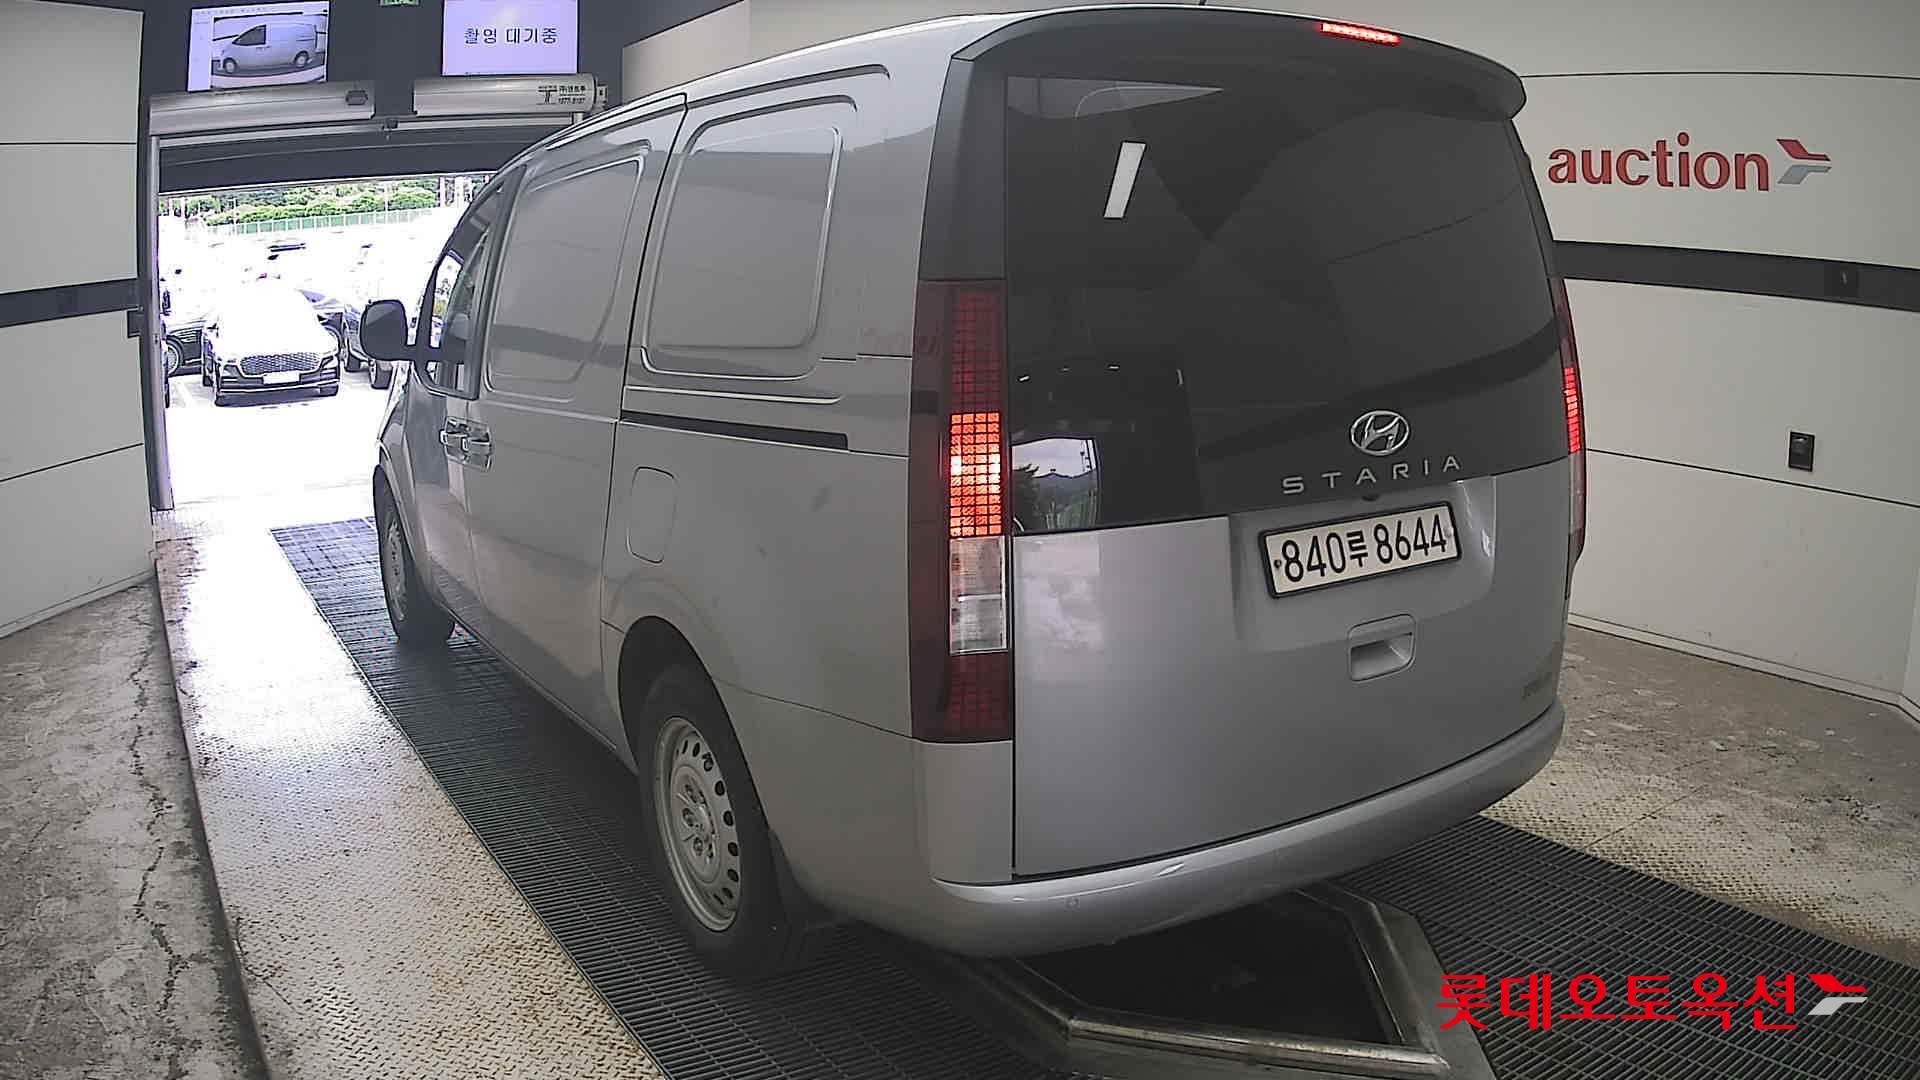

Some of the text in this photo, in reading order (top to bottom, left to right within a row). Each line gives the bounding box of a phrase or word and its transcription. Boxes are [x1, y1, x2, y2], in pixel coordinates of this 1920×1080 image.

[506, 27, 558, 44] 대기중
[1549, 131, 1769, 191] auction
[1282, 455, 1461, 494] STARIA
[1373, 514, 1447, 565] 8644
